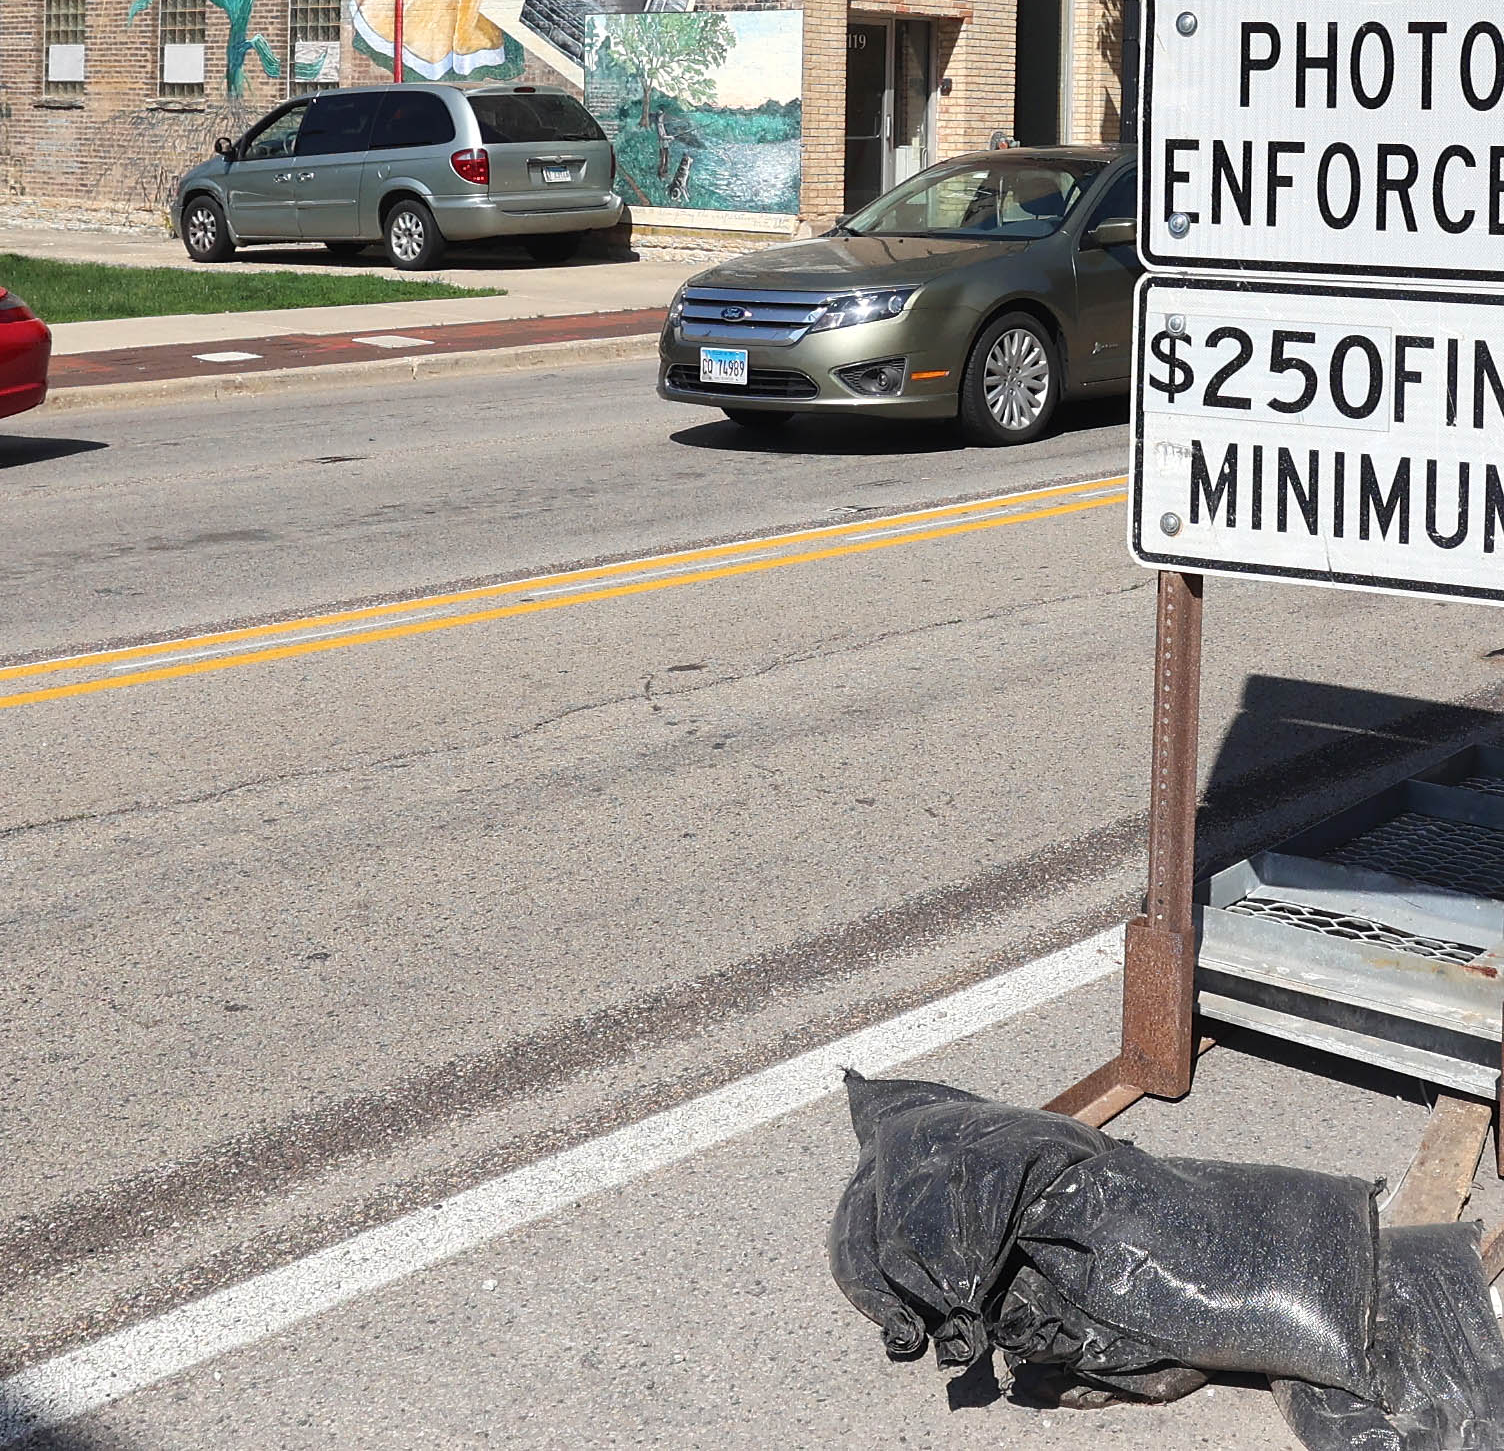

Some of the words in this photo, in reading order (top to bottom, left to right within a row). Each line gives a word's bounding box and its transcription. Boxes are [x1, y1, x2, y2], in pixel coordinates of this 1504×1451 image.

[848, 33, 867, 50] 119
[718, 359, 745, 377] 74989
[1149, 325, 1384, 420] $250
